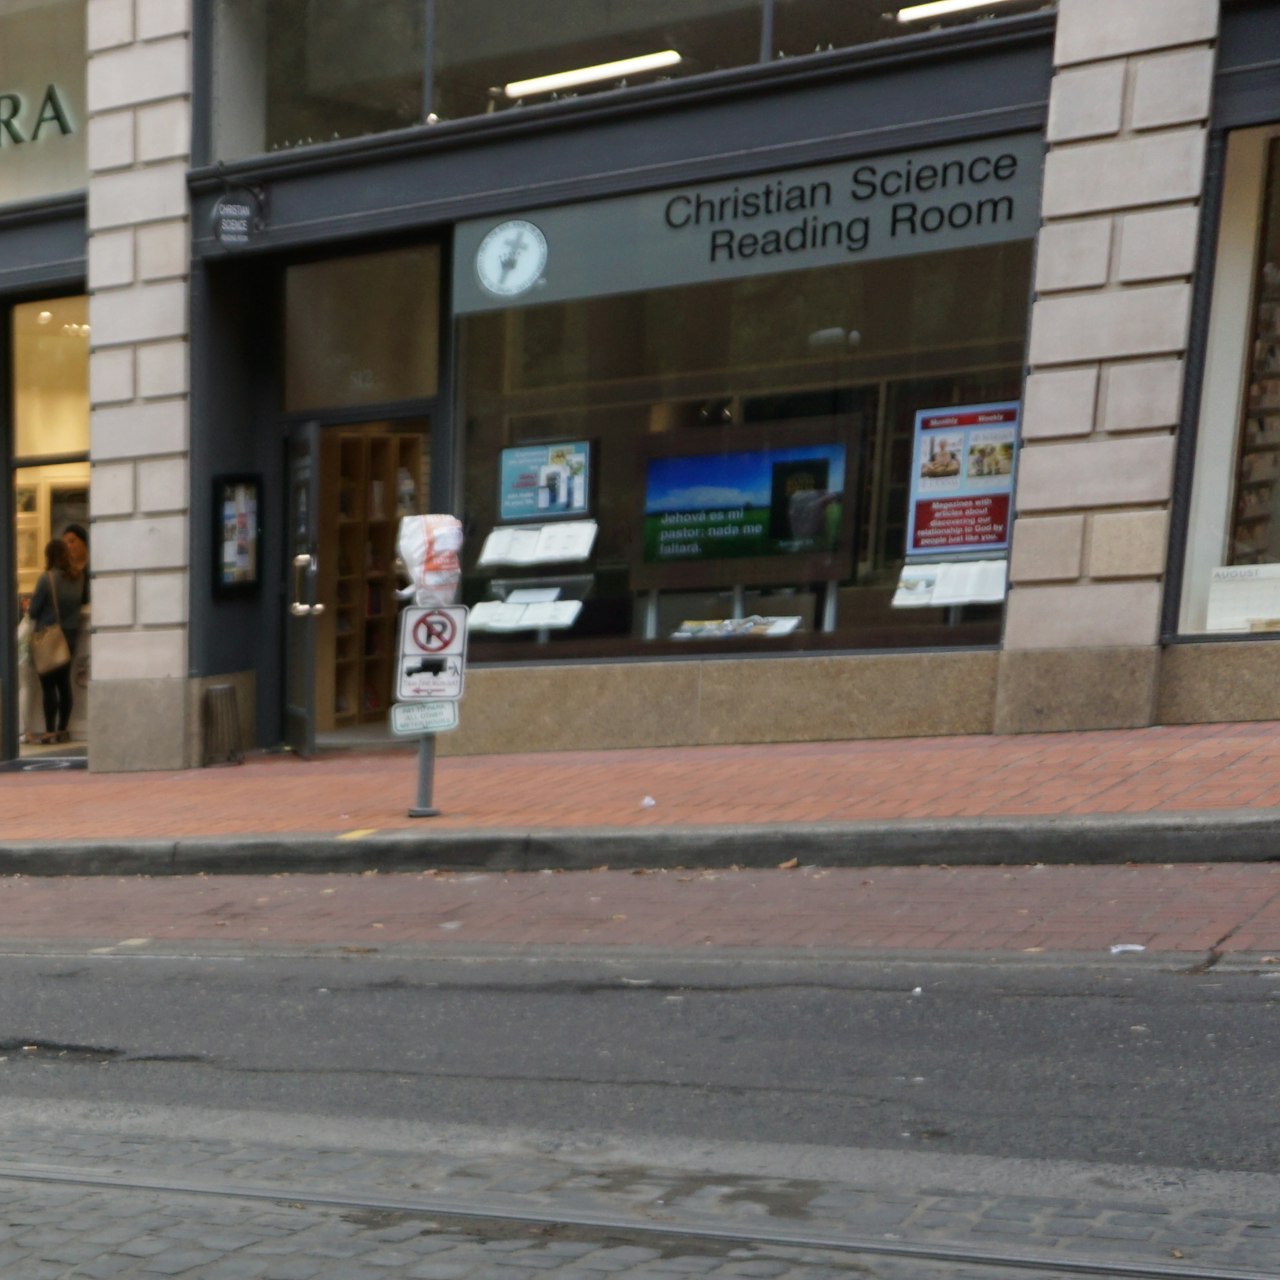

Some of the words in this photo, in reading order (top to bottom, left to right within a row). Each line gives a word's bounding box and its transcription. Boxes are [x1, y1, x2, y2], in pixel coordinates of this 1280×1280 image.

[664, 180, 832, 229] Christian
[850, 152, 1018, 202] Science
[218, 203, 251, 216] CHRISTIAN
[221, 218, 248, 231] SCIENCE
[709, 215, 870, 263] Reading
[889, 194, 1015, 238] Room
[977, 413, 1005, 422] Weekly
[932, 500, 973, 510] Magazines
[975, 498, 993, 506] with
[660, 509, 706, 525] Jehová
[709, 512, 724, 521] es
[727, 508, 745, 520] mi
[934, 508, 963, 517] articles
[965, 507, 988, 515] about
[930, 517, 976, 527] discovering
[707, 523, 740, 536] nada
[742, 523, 763, 535] me
[917, 526, 963, 536] relationship
[975, 524, 992, 532] God
[993, 523, 1004, 532] by
[920, 536, 947, 545] people
[948, 535, 963, 543] just
[1214, 568, 1259, 580] AUGUST
